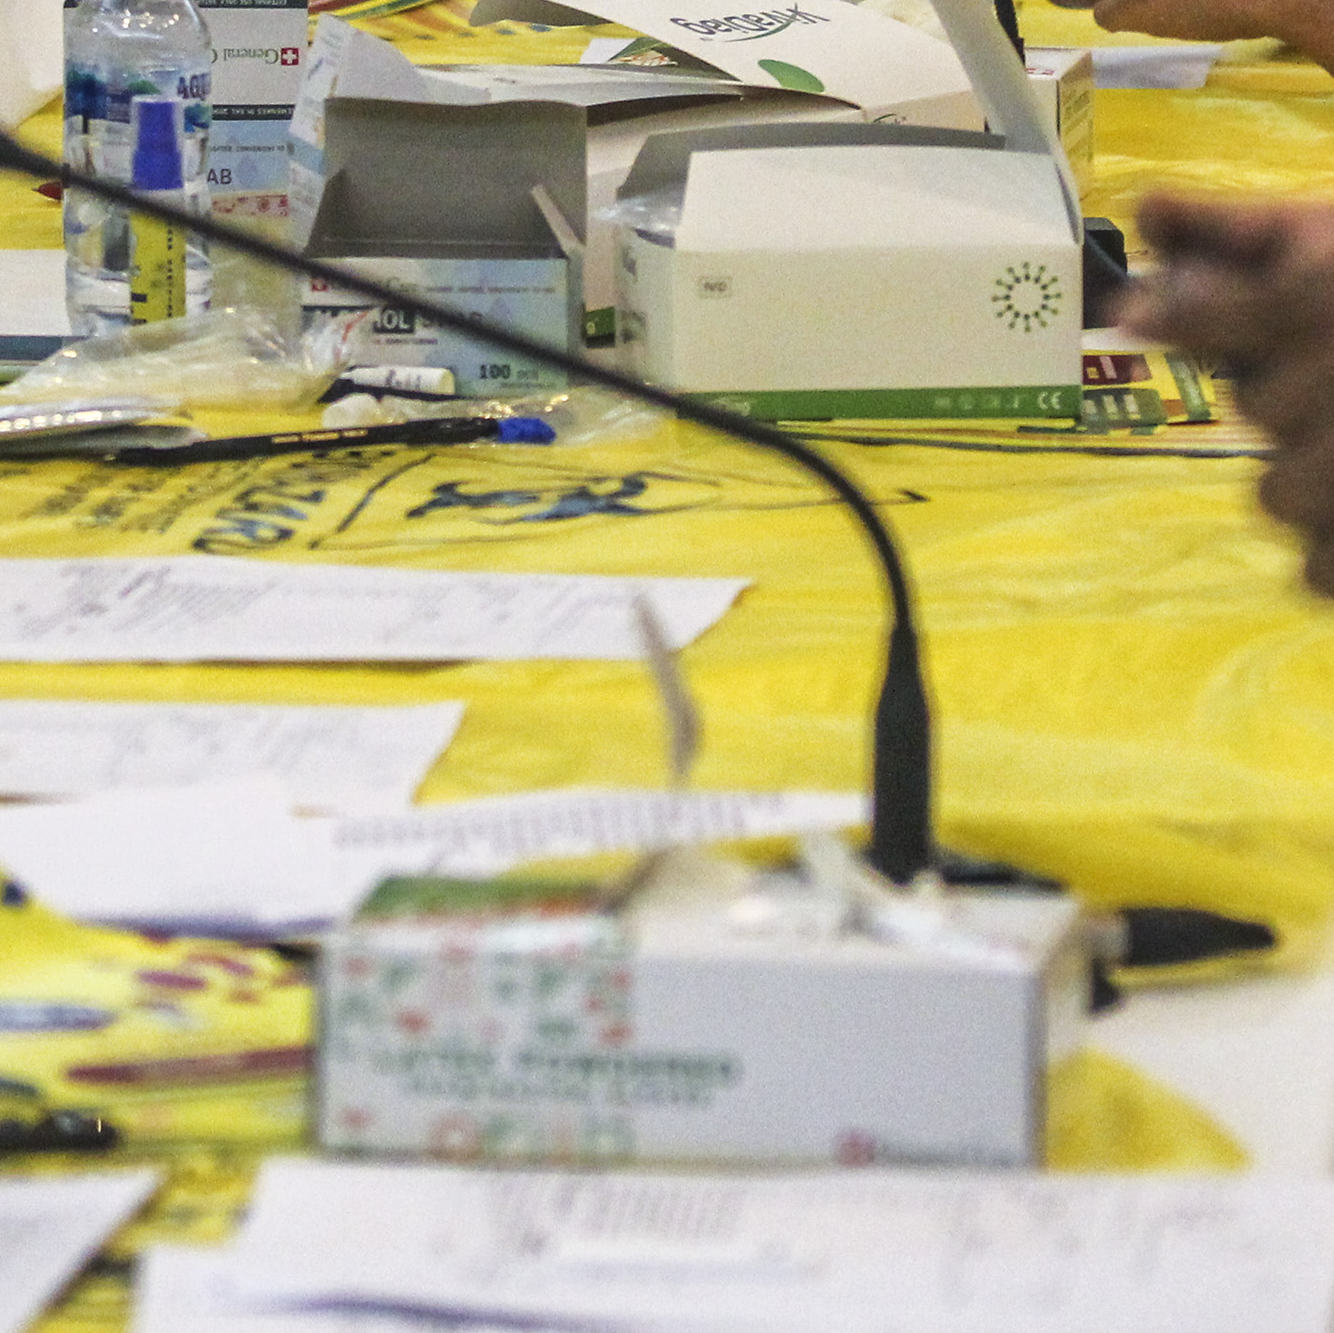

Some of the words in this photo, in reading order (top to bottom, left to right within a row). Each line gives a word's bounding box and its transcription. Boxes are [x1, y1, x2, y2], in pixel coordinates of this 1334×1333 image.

[670, 3, 831, 37] VivaDiag
[223, 48, 279, 65] General
[479, 364, 511, 380] 100
